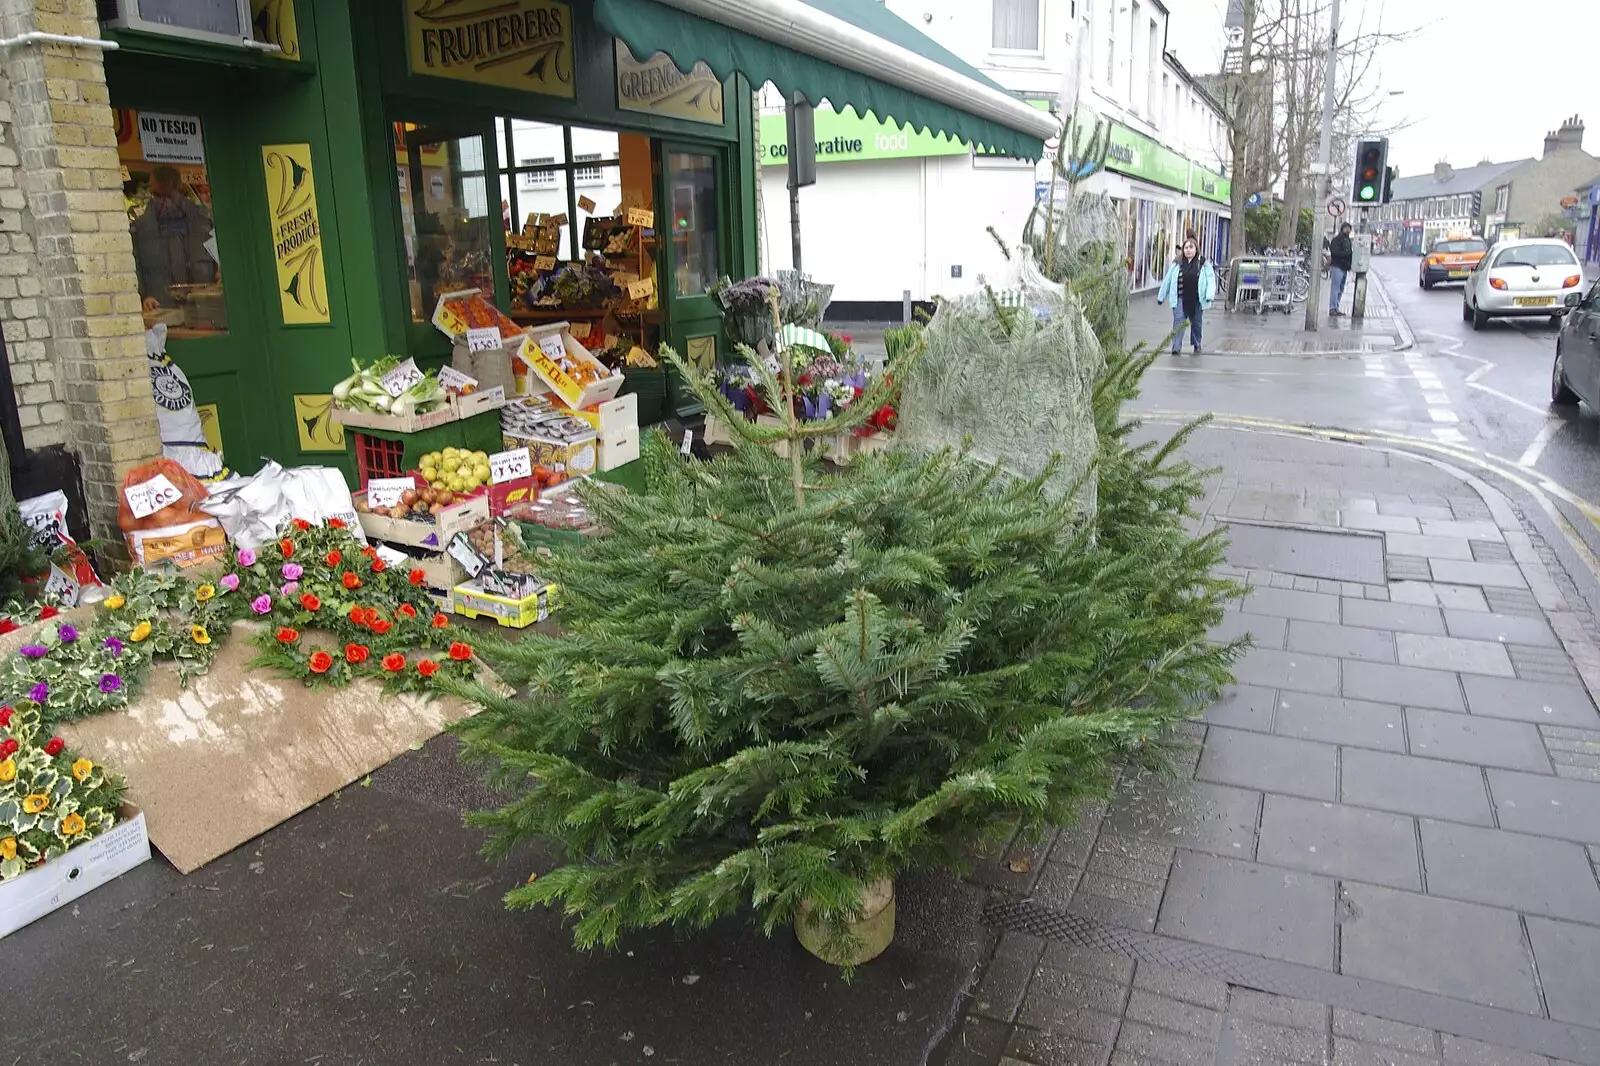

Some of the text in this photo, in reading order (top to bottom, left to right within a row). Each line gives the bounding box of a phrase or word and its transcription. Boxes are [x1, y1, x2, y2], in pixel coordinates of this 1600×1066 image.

[421, 8, 563, 67] FRUITERERS
[141, 117, 196, 135] NO TESCO
[874, 131, 909, 151] food
[1043, 151, 1059, 161] ZON
[279, 207, 314, 238] FRESH
[276, 220, 318, 260] PRODUCE
[171, 544, 226, 563] DEN HARV
